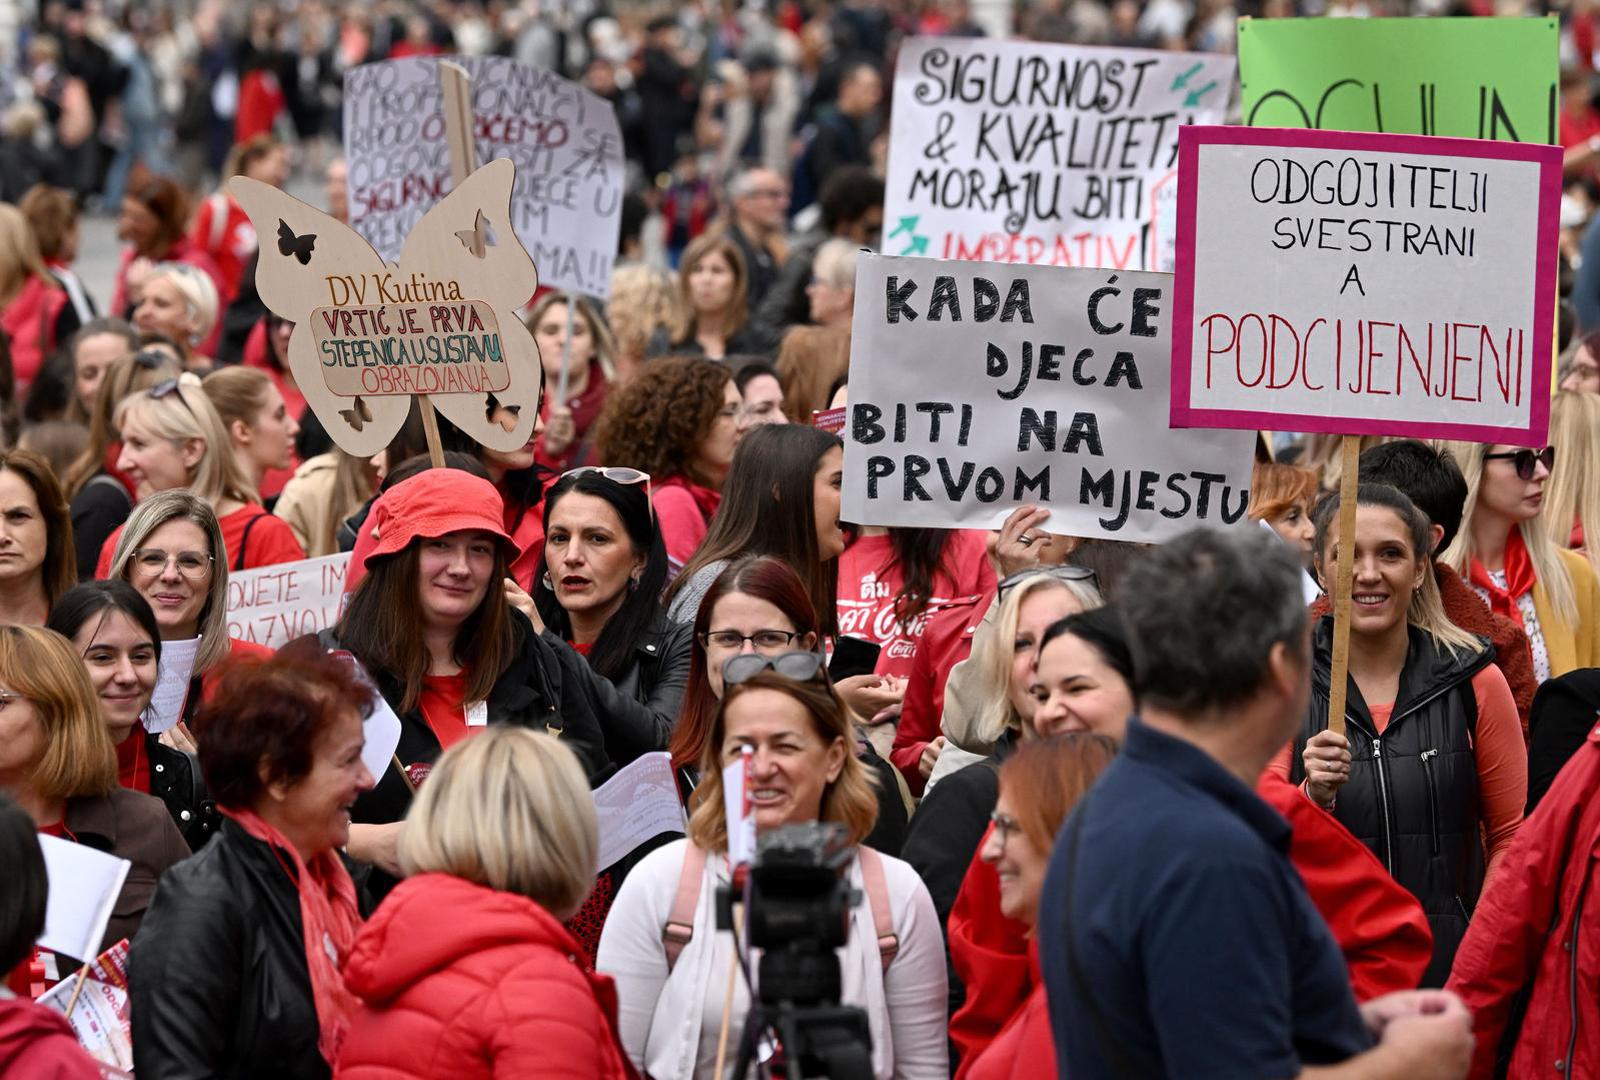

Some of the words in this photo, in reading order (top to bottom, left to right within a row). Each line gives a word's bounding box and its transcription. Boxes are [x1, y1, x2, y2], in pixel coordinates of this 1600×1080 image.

[914, 47, 1159, 113] SIGURNOST
[924, 111, 957, 164] &
[908, 166, 1063, 234] MORAJU
[1073, 174, 1143, 220] BITI
[1250, 157, 1488, 213] ODGOJITELJI
[1272, 217, 1475, 257] SVESTRANI
[325, 274, 366, 307] DV
[372, 273, 465, 305] Kutina
[885, 276, 1035, 324] KADA
[1087, 274, 1162, 338] ĆE
[1340, 264, 1366, 297] A
[322, 306, 390, 337] VRTIĆ
[397, 308, 425, 334] JE
[429, 305, 484, 333] PRVA
[321, 337, 411, 368] STEPENICA
[409, 338, 428, 365] U
[426, 333, 504, 365] SUSTAVU
[986, 340, 1143, 401] DJECA
[1200, 313, 1524, 407] PODCIJENJENI
[361, 365, 495, 393] OBRAZOVANJA
[851, 401, 973, 447] BITI
[1017, 407, 1104, 457] NA
[867, 454, 1051, 503] PRVOM
[1079, 466, 1249, 532] MJESTU
